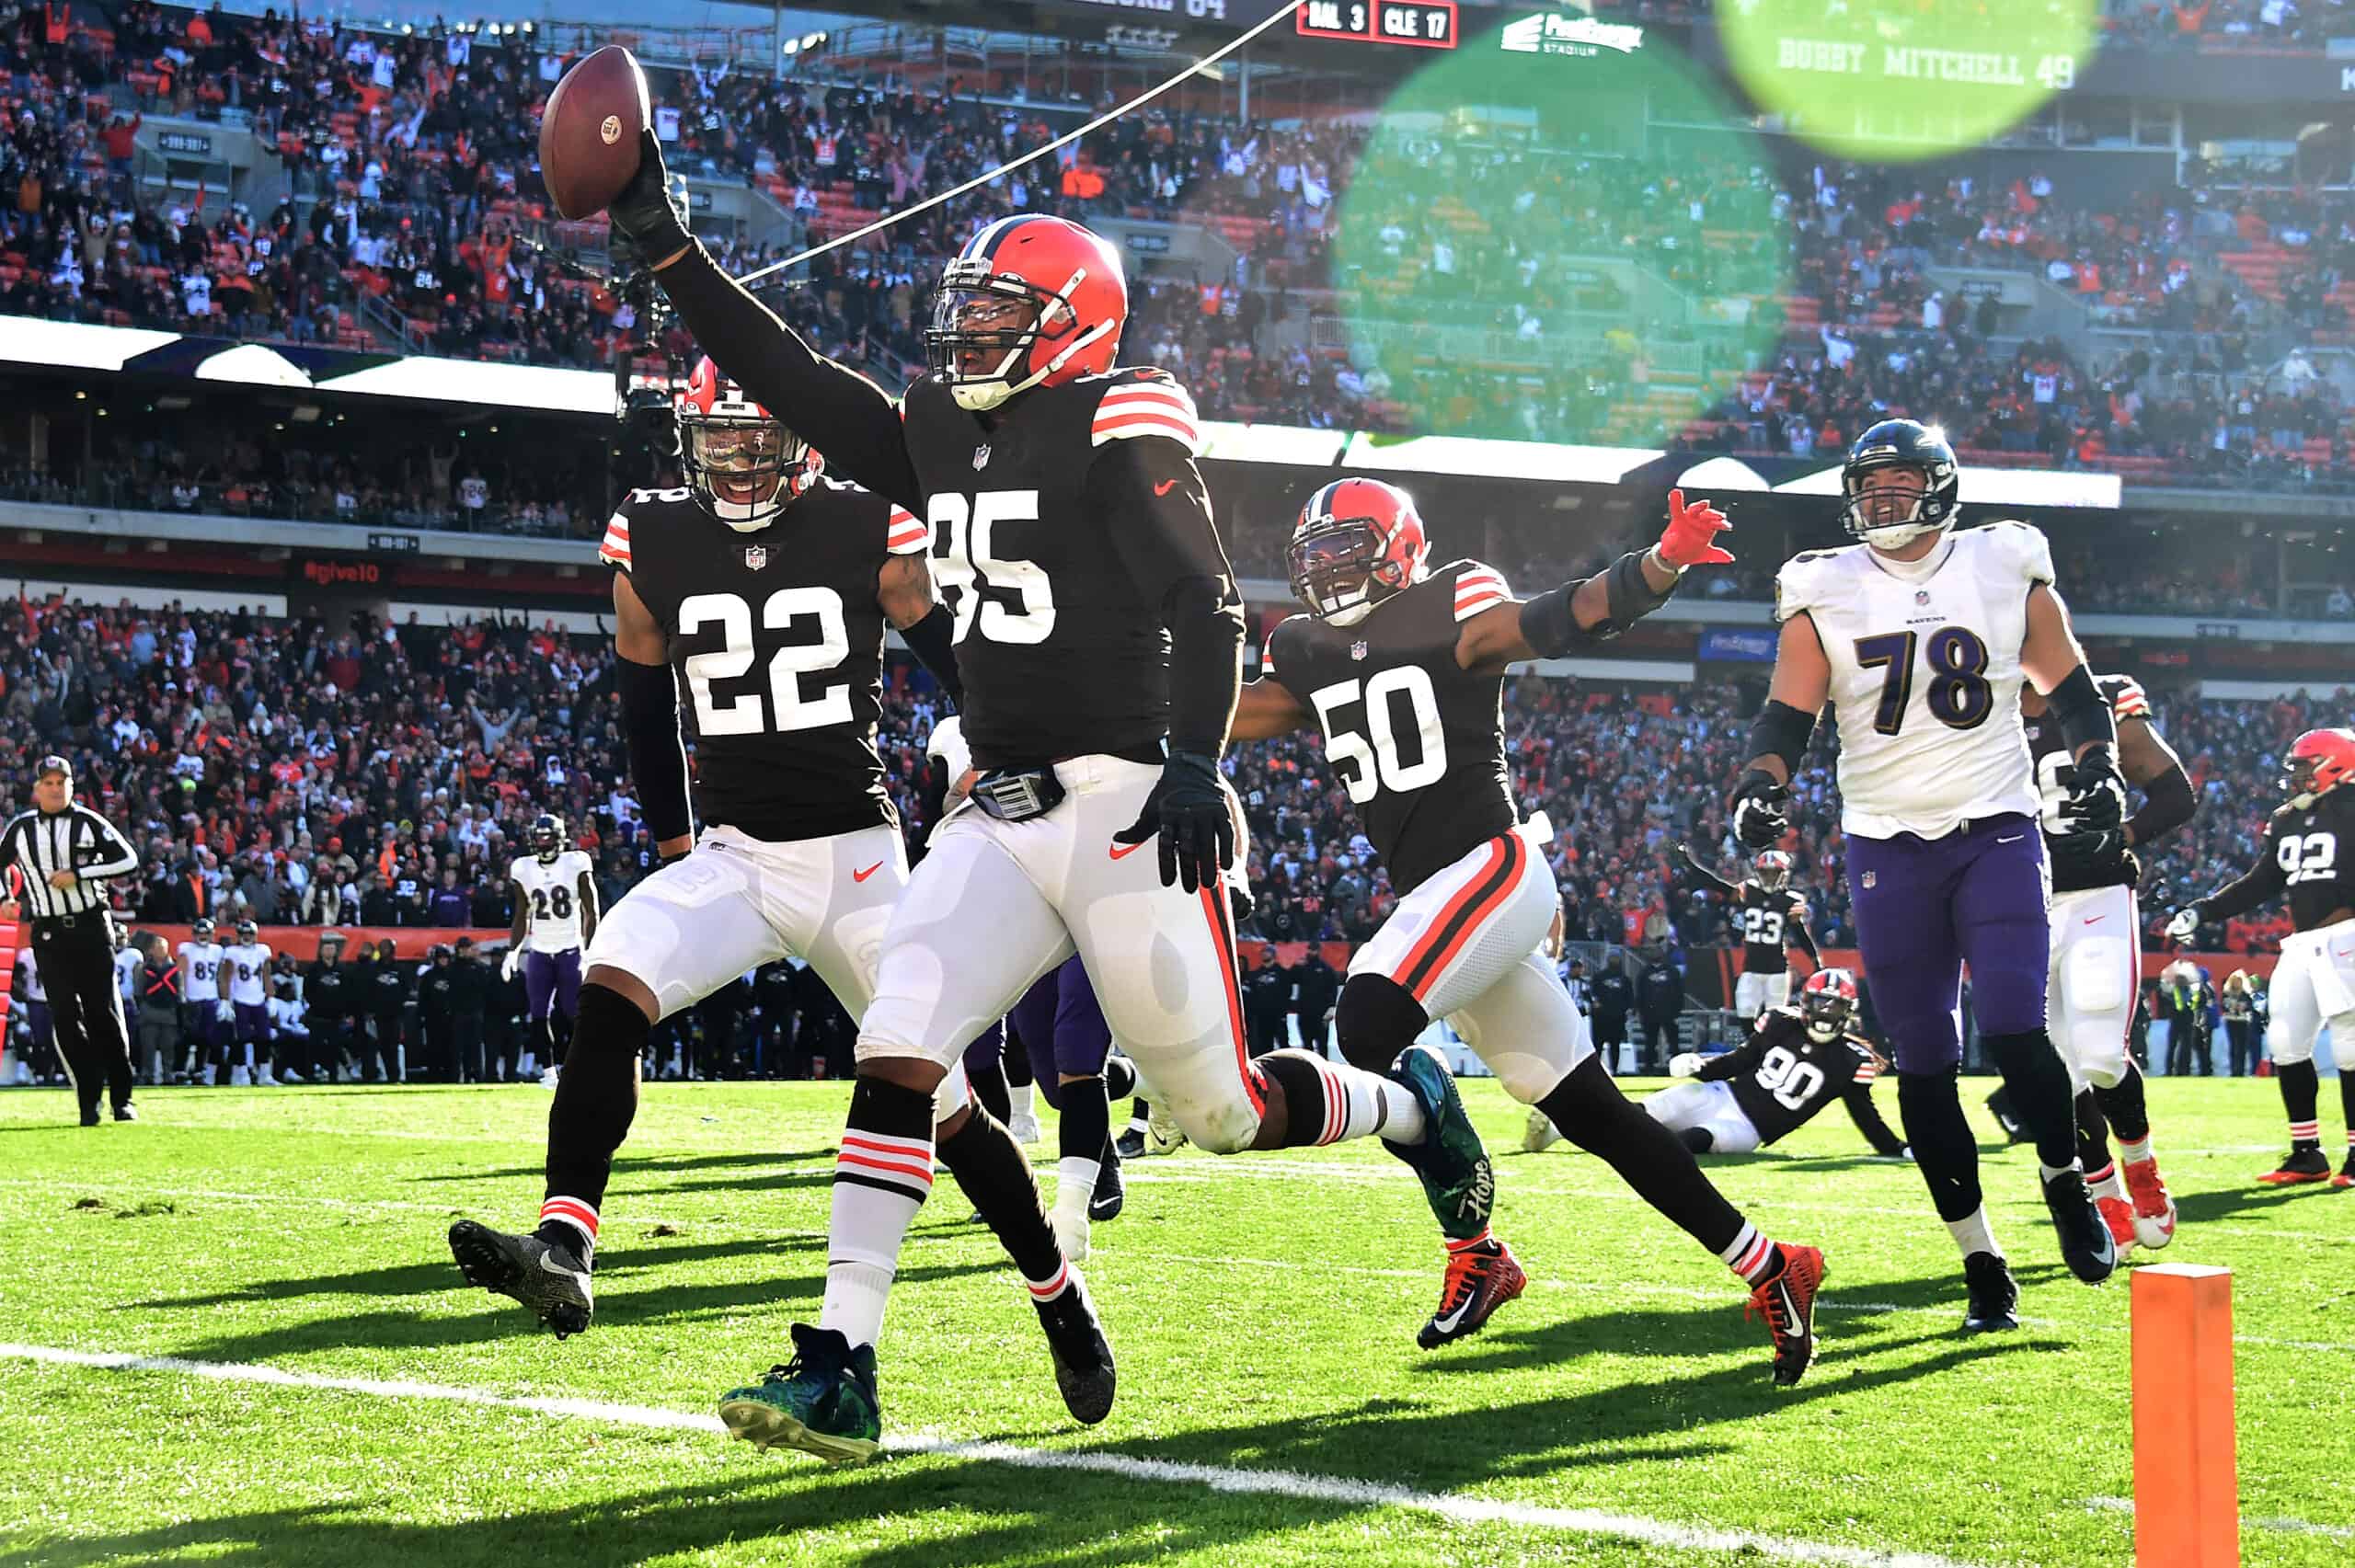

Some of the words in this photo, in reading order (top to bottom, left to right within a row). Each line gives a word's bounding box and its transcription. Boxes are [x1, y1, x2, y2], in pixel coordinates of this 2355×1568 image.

[1308, 1, 1341, 29] BAL
[1350, 4, 1364, 31] 3
[1384, 7, 1418, 36] CLE
[1427, 12, 1447, 39] 17
[1543, 43, 1598, 56] STADIUM
[1778, 39, 1865, 73] BOBBY
[1884, 46, 2024, 85] MITCHELL
[2036, 54, 2074, 89] 49
[304, 560, 379, 585] #give10
[927, 490, 1056, 647] 95
[679, 586, 854, 736] 22
[1853, 626, 1993, 736] 78
[1309, 665, 1448, 804] 50
[2277, 832, 2337, 885] 92
[531, 885, 572, 921] 28
[1744, 907, 1783, 944] 23
[194, 961, 216, 981] 85
[238, 963, 263, 982] 84
[1754, 1045, 1825, 1111] 90
[1466, 1158, 1494, 1221] Hope
